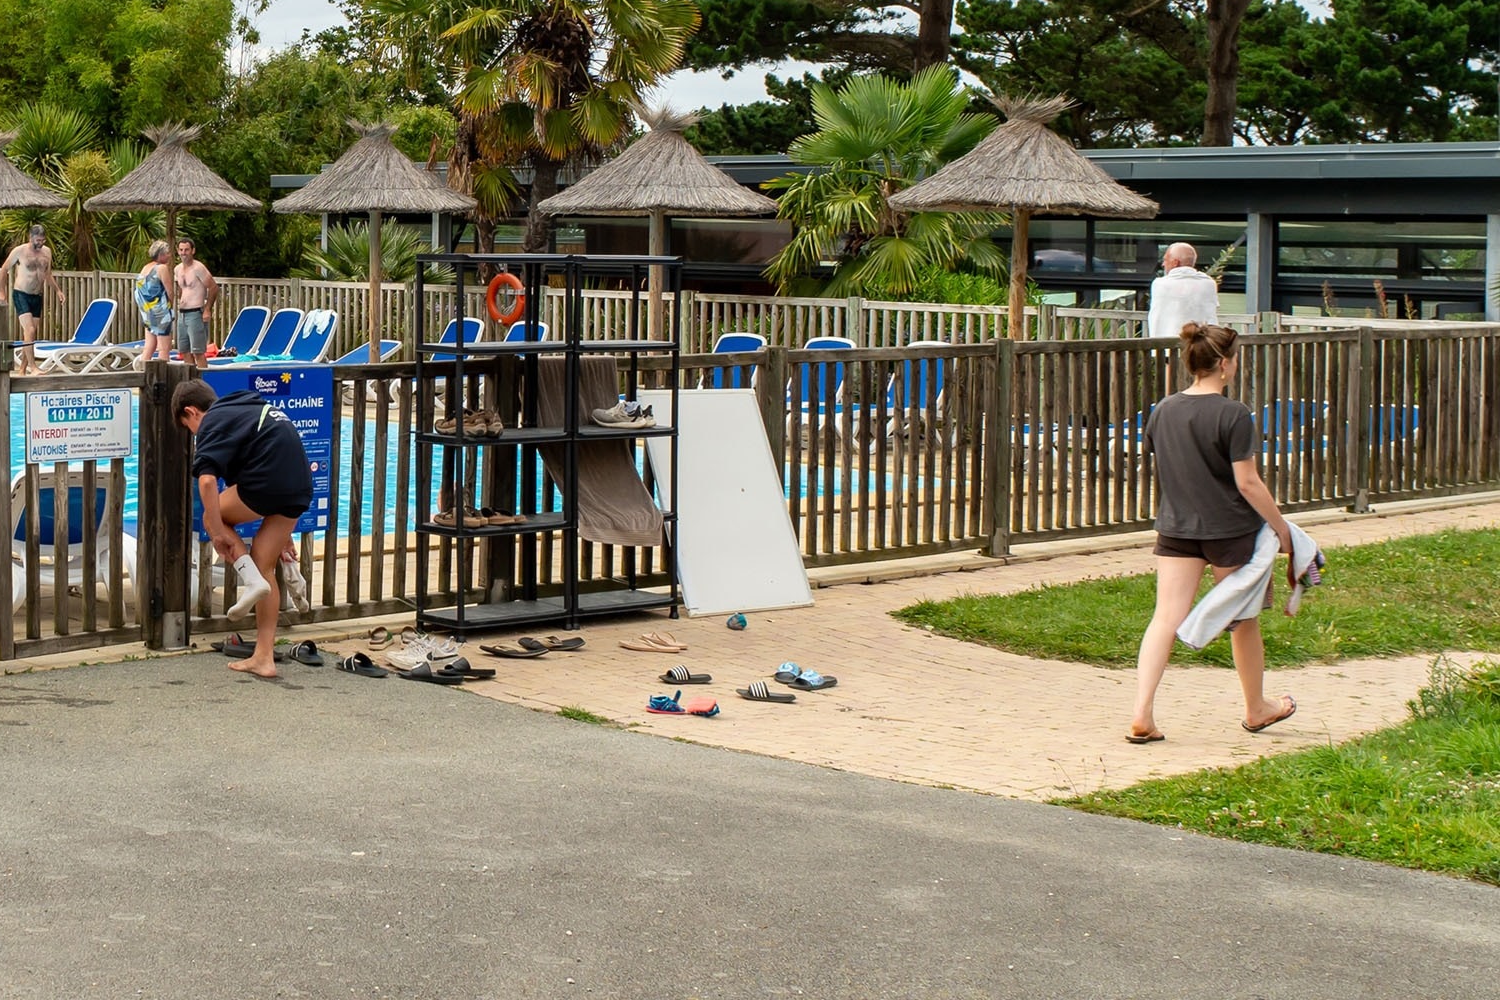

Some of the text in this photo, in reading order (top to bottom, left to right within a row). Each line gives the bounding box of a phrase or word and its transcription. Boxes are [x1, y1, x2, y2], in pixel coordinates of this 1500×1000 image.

[287, 396, 324, 409] CHAÎNE
[51, 409, 65, 421] 10
[68, 408, 77, 420] H
[86, 407, 100, 419] 20
[103, 407, 112, 419] H
[32, 428, 68, 439] INTERDIT
